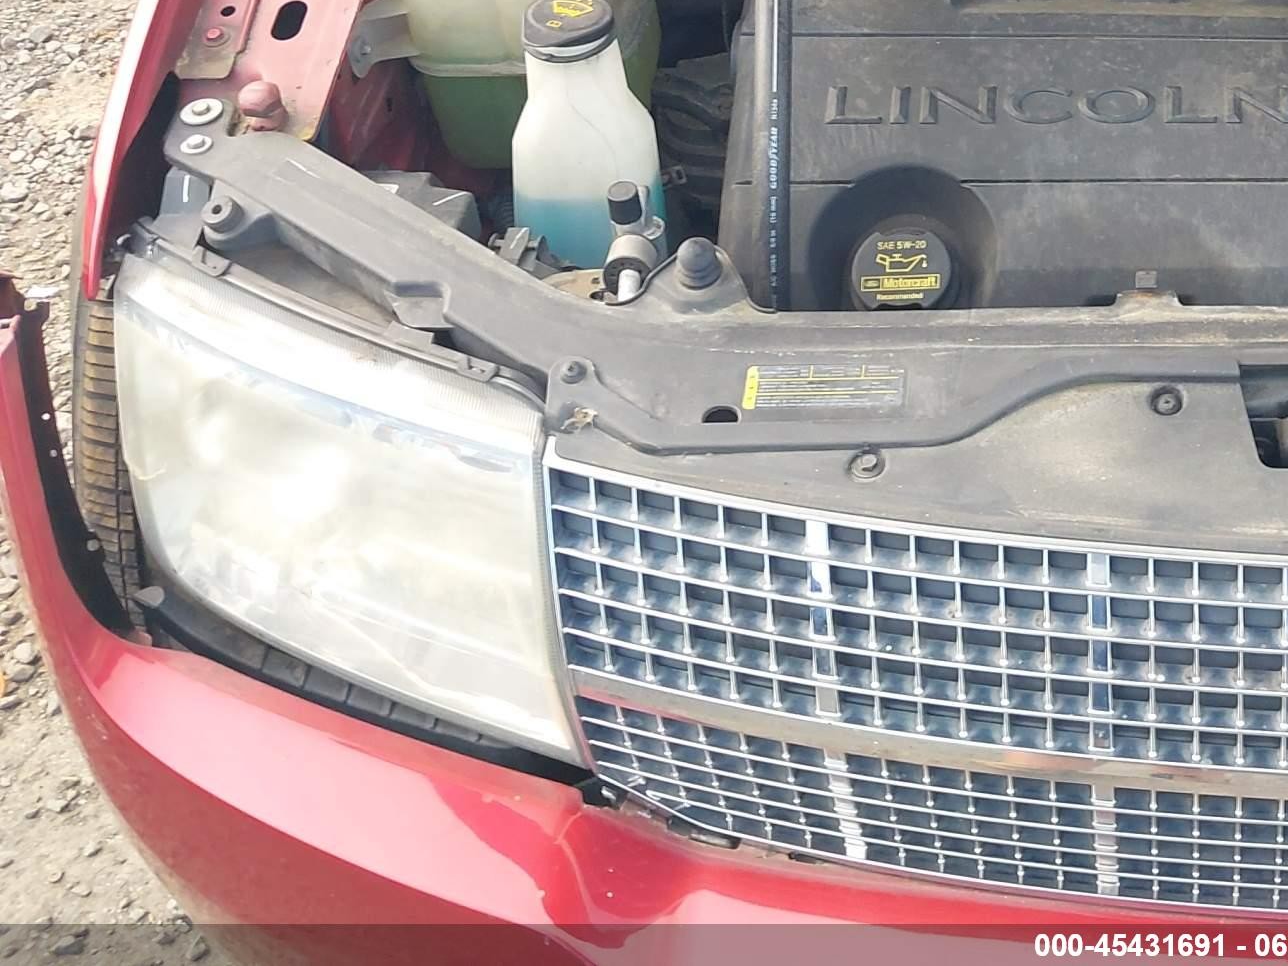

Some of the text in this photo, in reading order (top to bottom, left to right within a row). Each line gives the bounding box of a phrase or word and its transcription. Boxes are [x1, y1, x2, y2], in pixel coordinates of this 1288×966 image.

[768, 126, 779, 189] GOODYEAR
[876, 240, 927, 251] SAE 5W-20
[882, 276, 937, 289] Motorcraft
